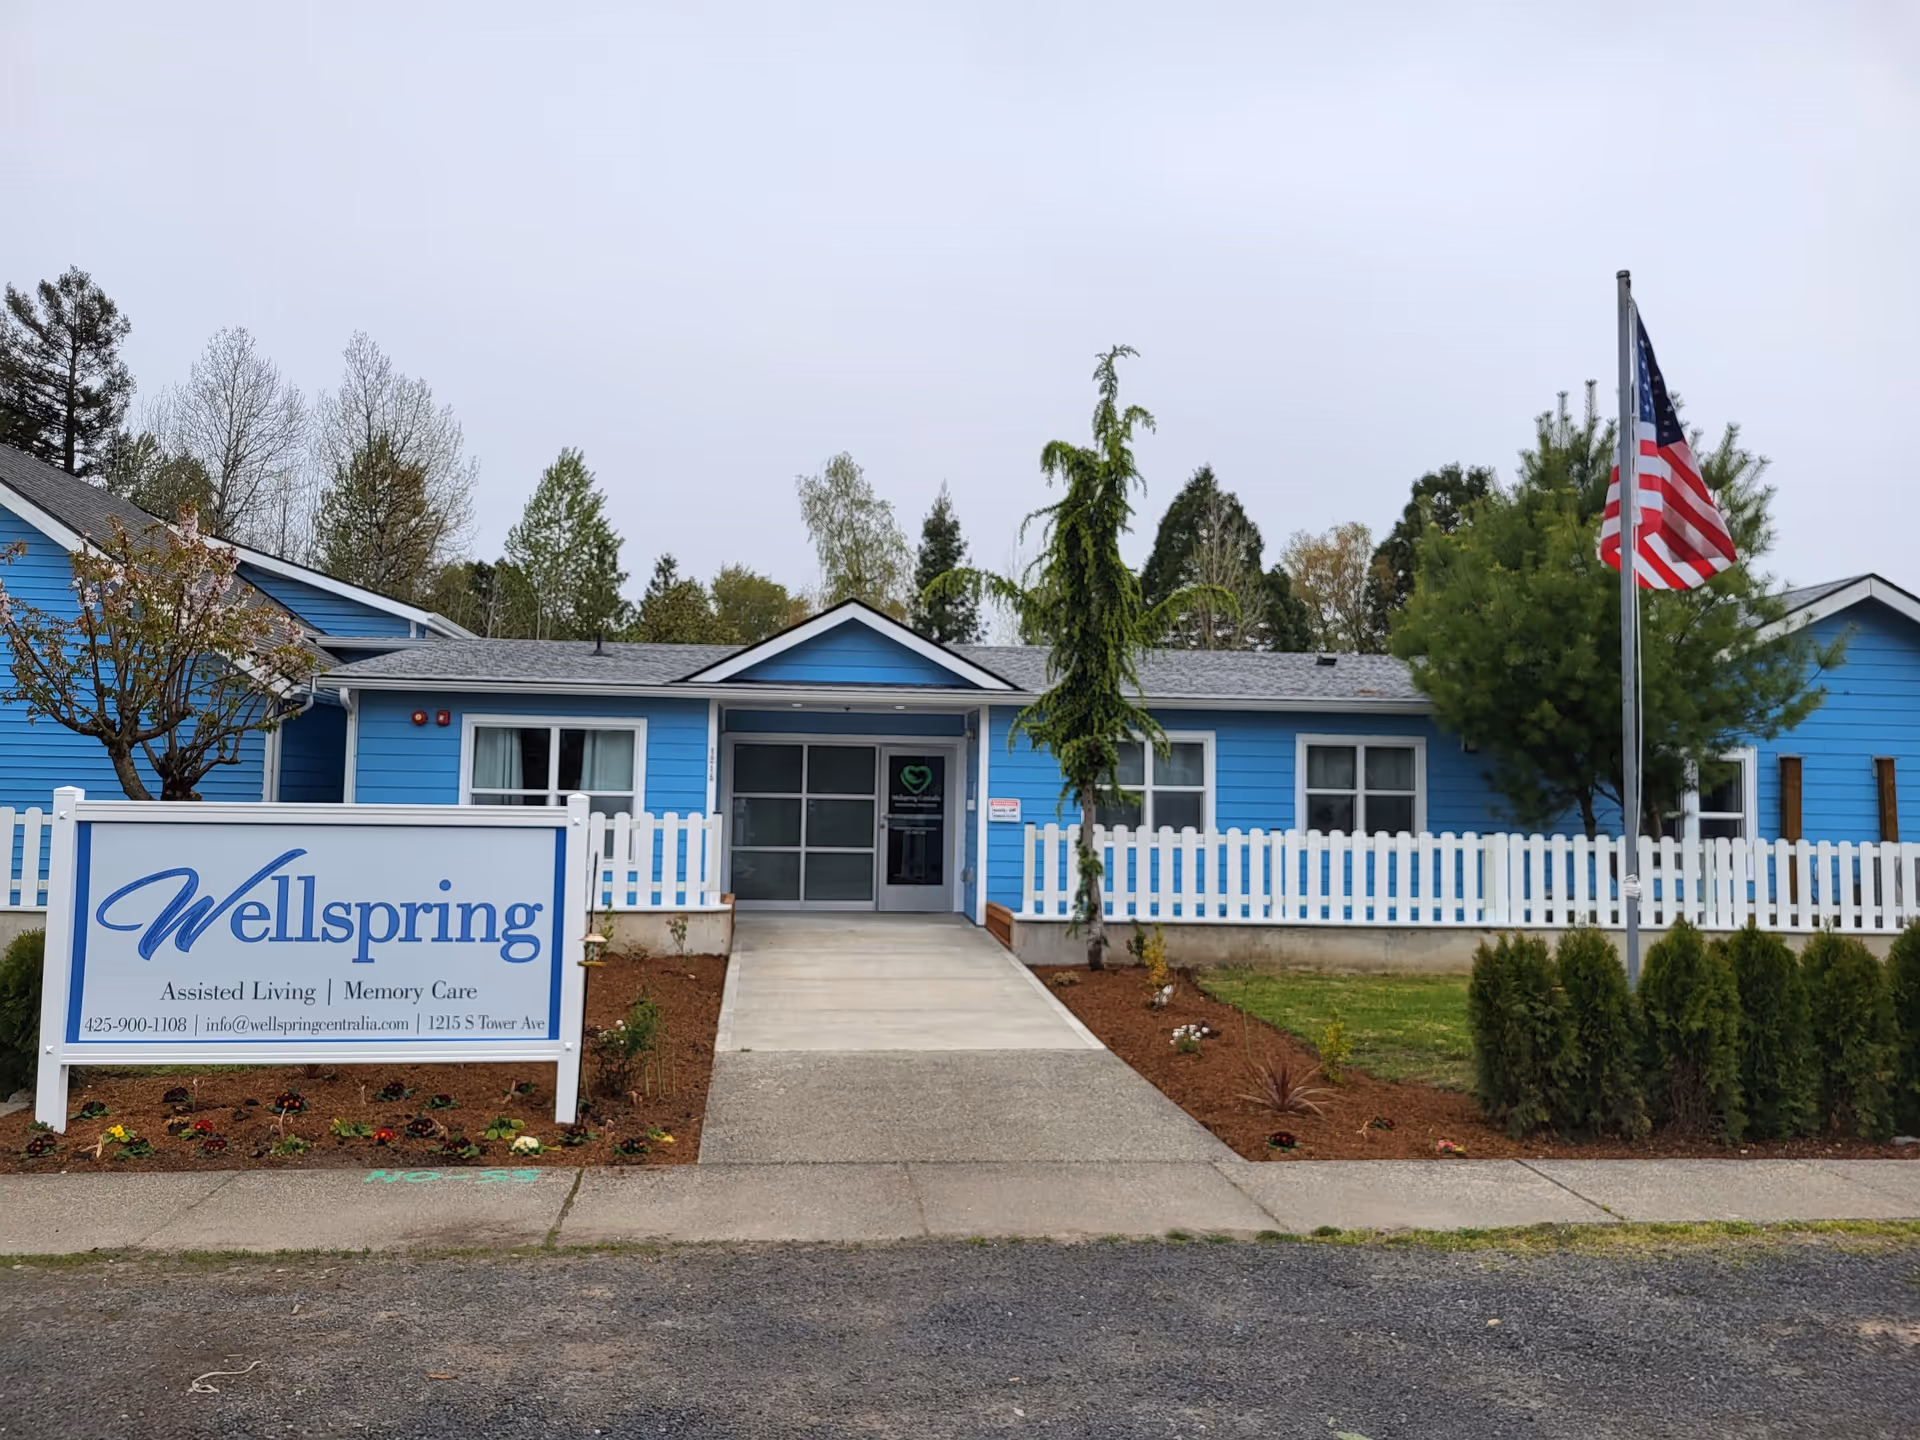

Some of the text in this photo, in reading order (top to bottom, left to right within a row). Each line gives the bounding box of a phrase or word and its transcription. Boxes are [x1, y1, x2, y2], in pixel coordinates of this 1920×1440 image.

[95, 848, 545, 964] Wellspring
[159, 979, 478, 1006] Assisted Living Memory Care
[84, 1014, 546, 1036] 425-900-1108 info@wellspringcentralia.com 1215 S Tower Ave
